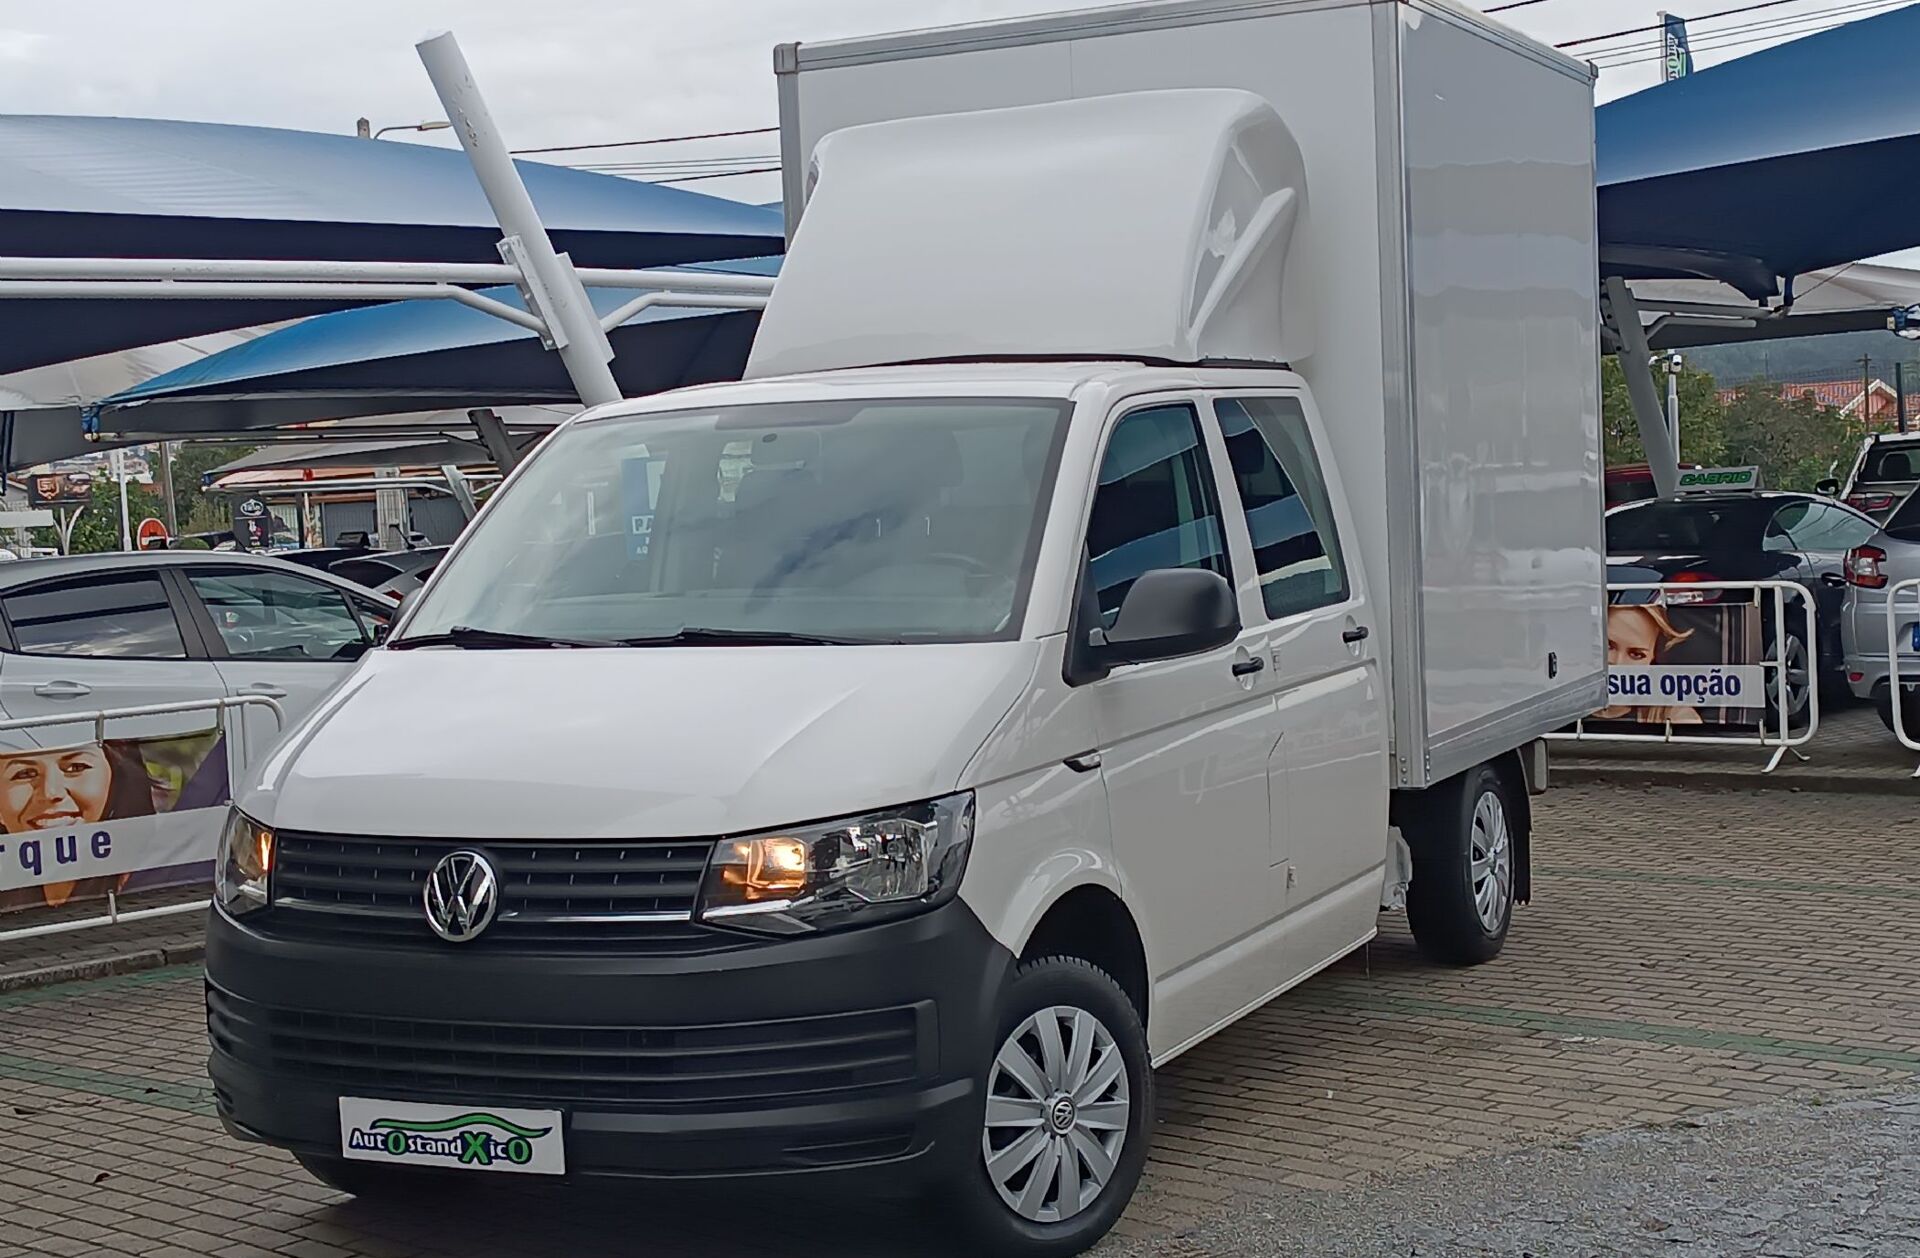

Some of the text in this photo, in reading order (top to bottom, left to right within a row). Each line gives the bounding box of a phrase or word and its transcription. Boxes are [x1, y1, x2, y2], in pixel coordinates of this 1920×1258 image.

[1608, 668, 1742, 704] sua opção
[0, 829, 112, 876] que
